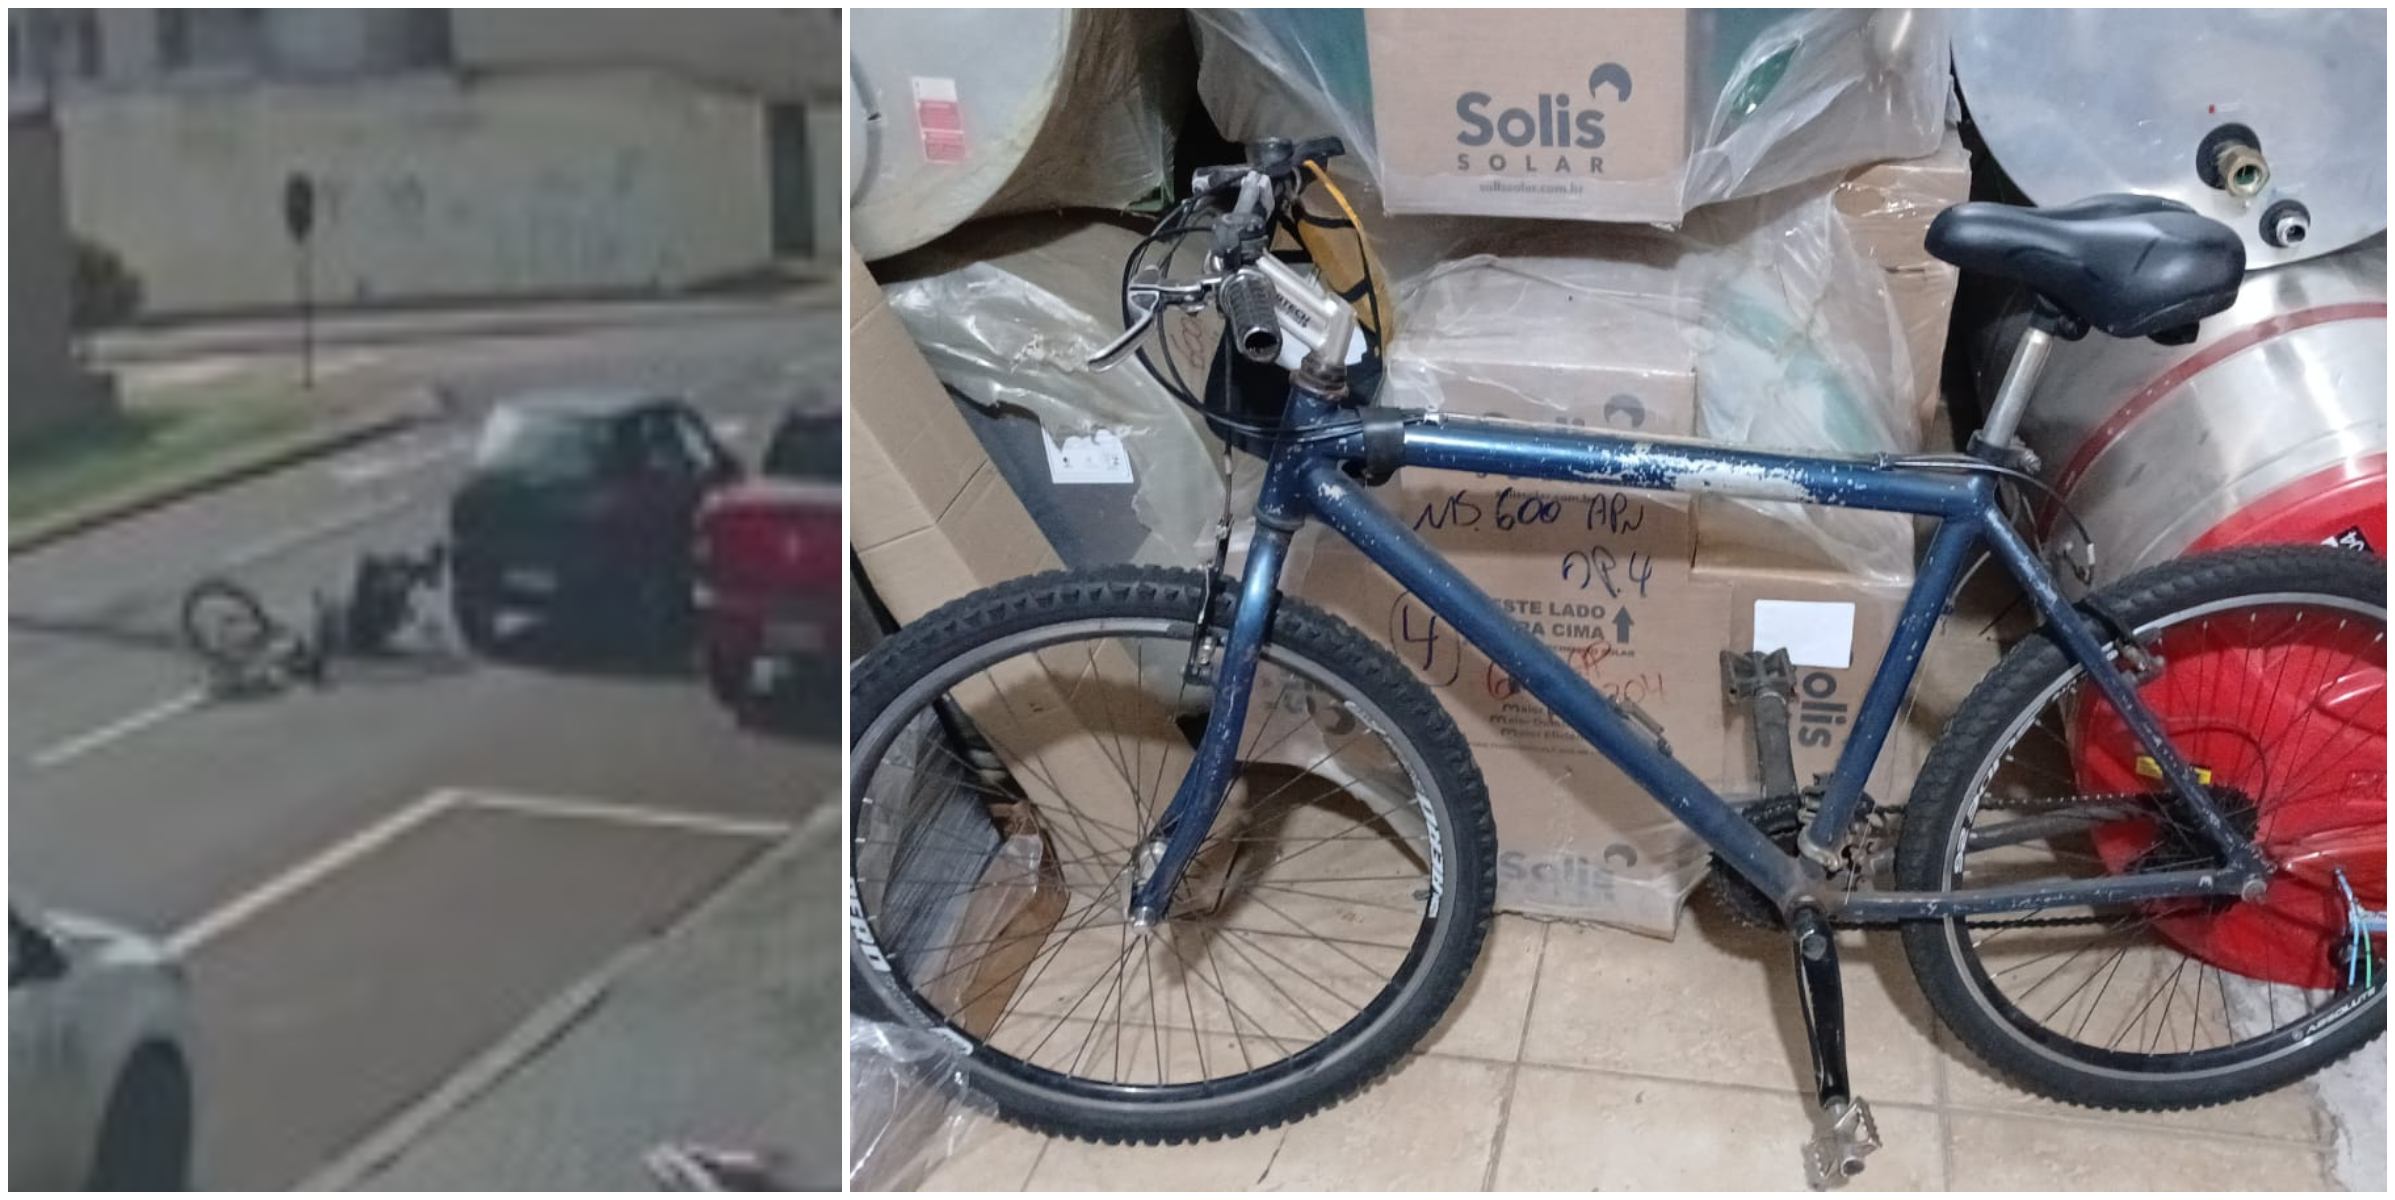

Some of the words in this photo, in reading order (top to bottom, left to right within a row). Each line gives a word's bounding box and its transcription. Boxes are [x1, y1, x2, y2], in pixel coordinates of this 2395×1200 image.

[1456, 91, 1606, 149] Solis
[1457, 154, 1604, 174] SOLAR
[1502, 600, 1542, 615] STE
[1549, 602, 1606, 619] LADO
[1552, 623, 1605, 640] CIMA
[1798, 671, 1848, 748] olis
